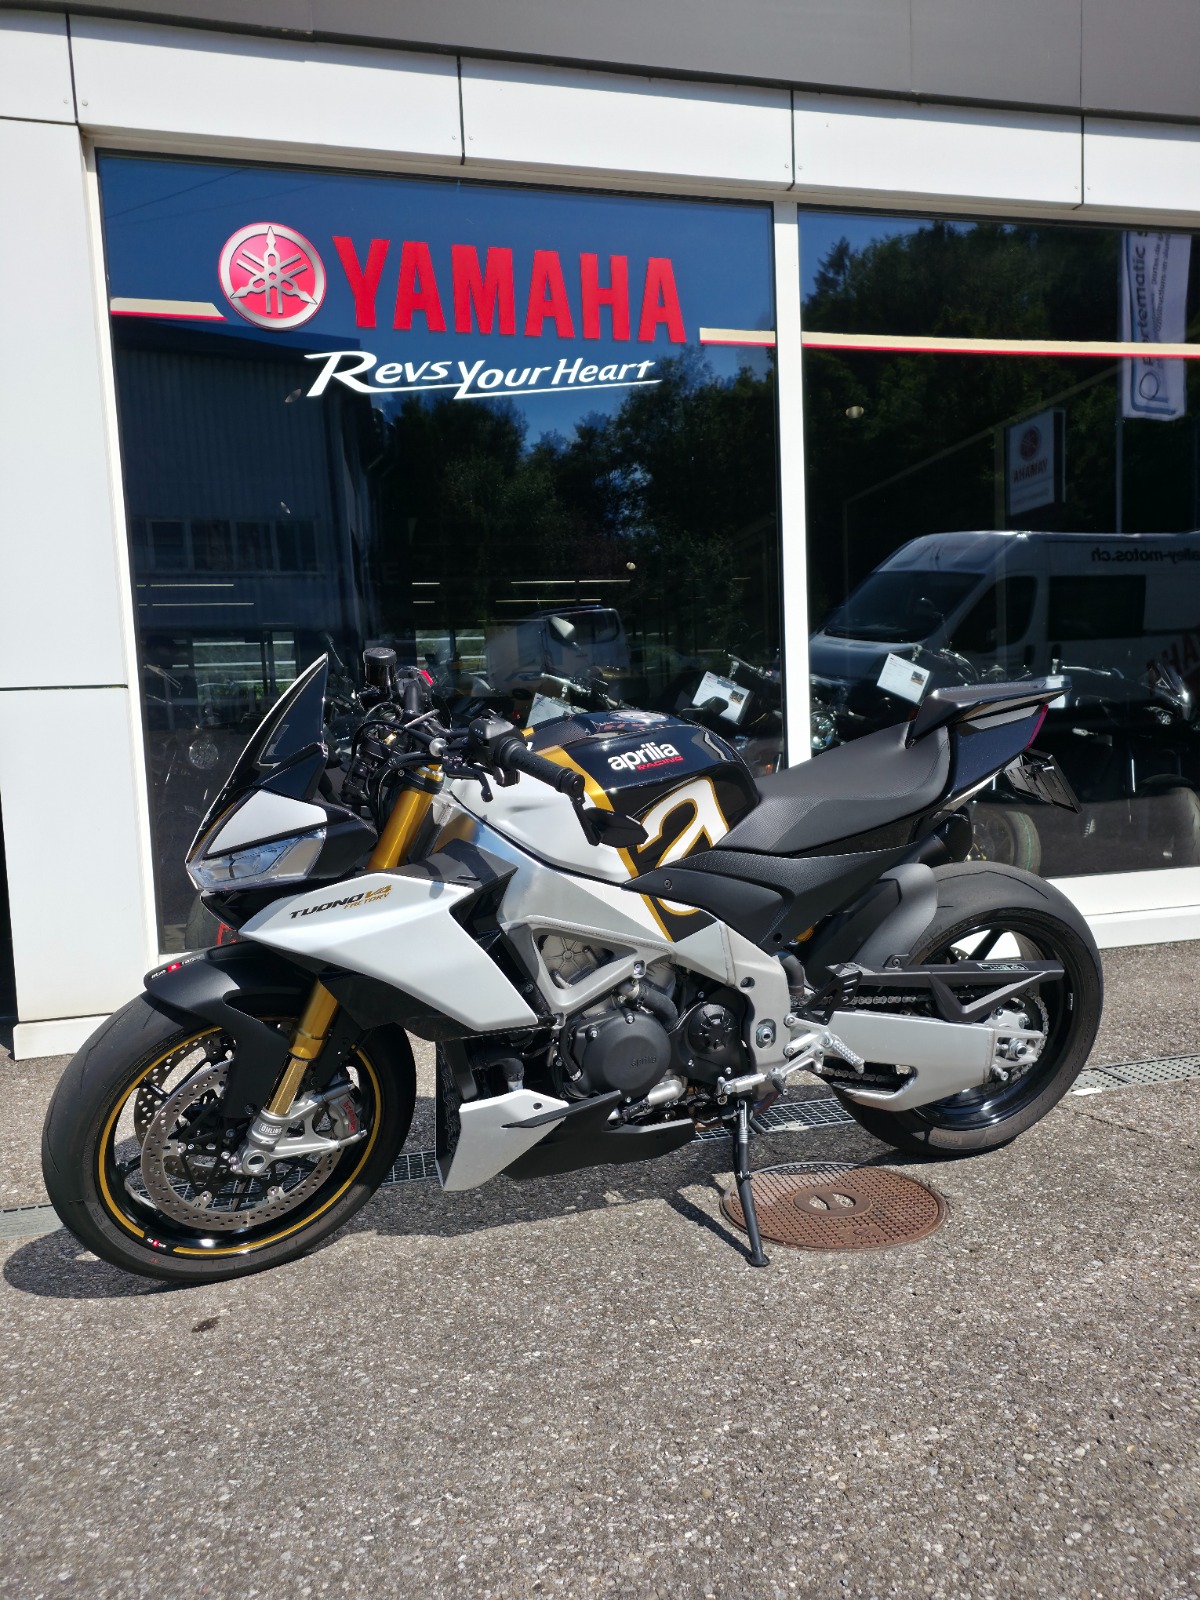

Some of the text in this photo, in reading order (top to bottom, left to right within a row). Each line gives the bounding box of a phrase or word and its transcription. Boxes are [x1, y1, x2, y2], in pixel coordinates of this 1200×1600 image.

[332, 236, 687, 343] YAMAHA
[304, 350, 656, 399] Revs Your Heart
[607, 742, 680, 770] aprilia
[636, 755, 684, 771] RACING
[289, 893, 364, 919] TUONO
[343, 892, 390, 910] FACTORY
